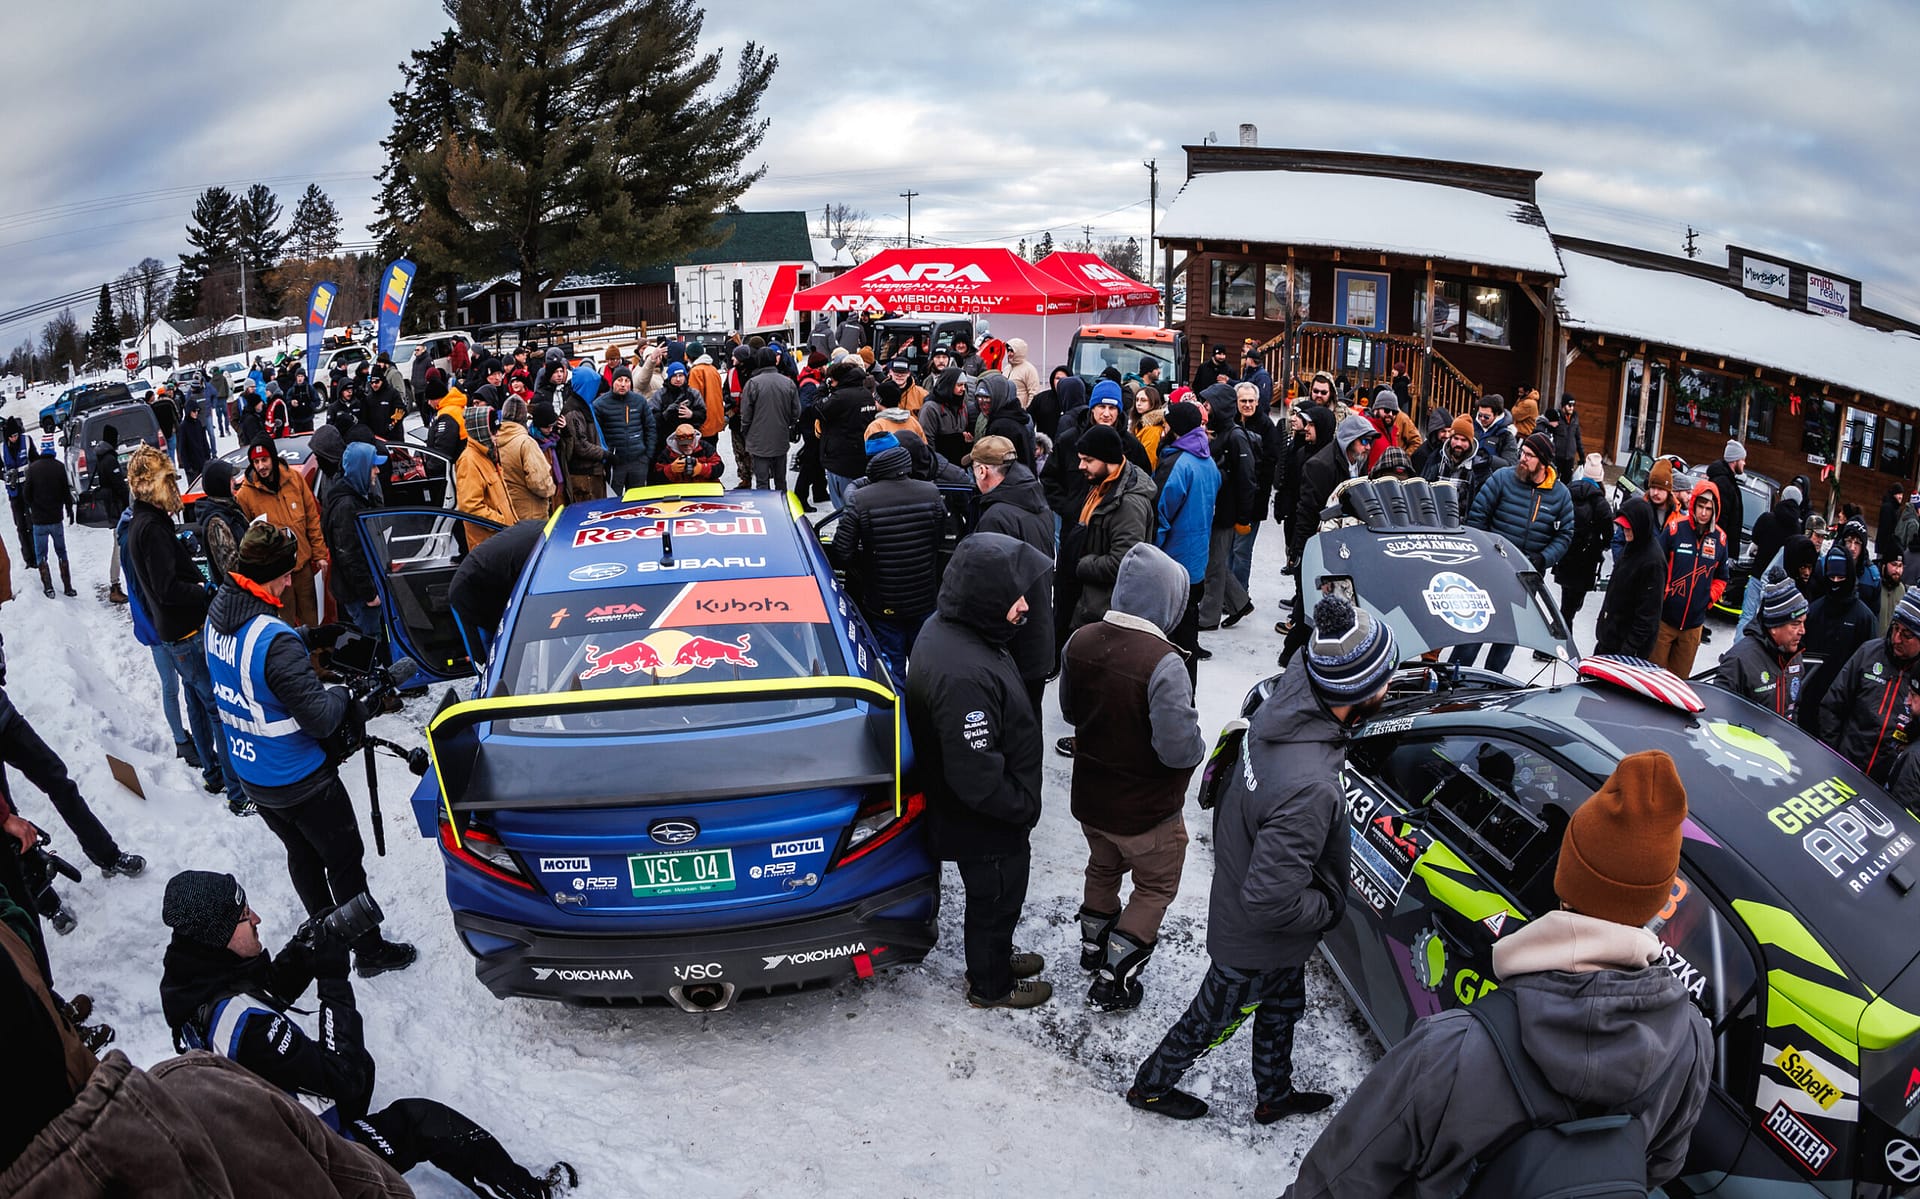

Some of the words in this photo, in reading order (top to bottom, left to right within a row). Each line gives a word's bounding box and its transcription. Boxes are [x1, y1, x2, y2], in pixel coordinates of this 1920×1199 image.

[862, 263, 992, 282] ARA
[1745, 266, 1785, 287] Movement
[1809, 275, 1833, 291] smith
[821, 295, 885, 311] ARA
[888, 295, 957, 304] AMERICAN
[961, 296, 1004, 305] RALLY
[1819, 286, 1845, 305] realty
[896, 304, 990, 312] ASSOCIATION
[125, 357, 138, 366] STOP
[573, 519, 668, 548] Red
[673, 516, 767, 537] Bull
[1386, 540, 1430, 552] IMPORTS
[637, 557, 766, 572] SUBARU
[585, 603, 646, 617] ARA
[696, 598, 789, 613] Kubota
[1431, 599, 1490, 610] PRECISION
[213, 682, 250, 709] ARA
[1372, 722, 1412, 735] AESTHETICS
[1767, 776, 1858, 835] GREEN
[1372, 826, 1396, 852] AMERICAN
[1802, 798, 1896, 878] APU
[775, 840, 821, 855] MOTUL
[543, 860, 588, 870] MOTUL
[644, 857, 682, 884] VSC
[693, 854, 719, 879] 04
[1849, 852, 1891, 893] RALLY
[1887, 836, 1912, 857] USA
[786, 942, 865, 965] YOKOHAMA
[555, 969, 633, 981] YOKOHAMA
[674, 963, 723, 980] VSC
[1661, 941, 1707, 1000] SZKA
[1781, 1053, 1835, 1105] Sabelt
[1766, 1105, 1830, 1169] ROTTLER
